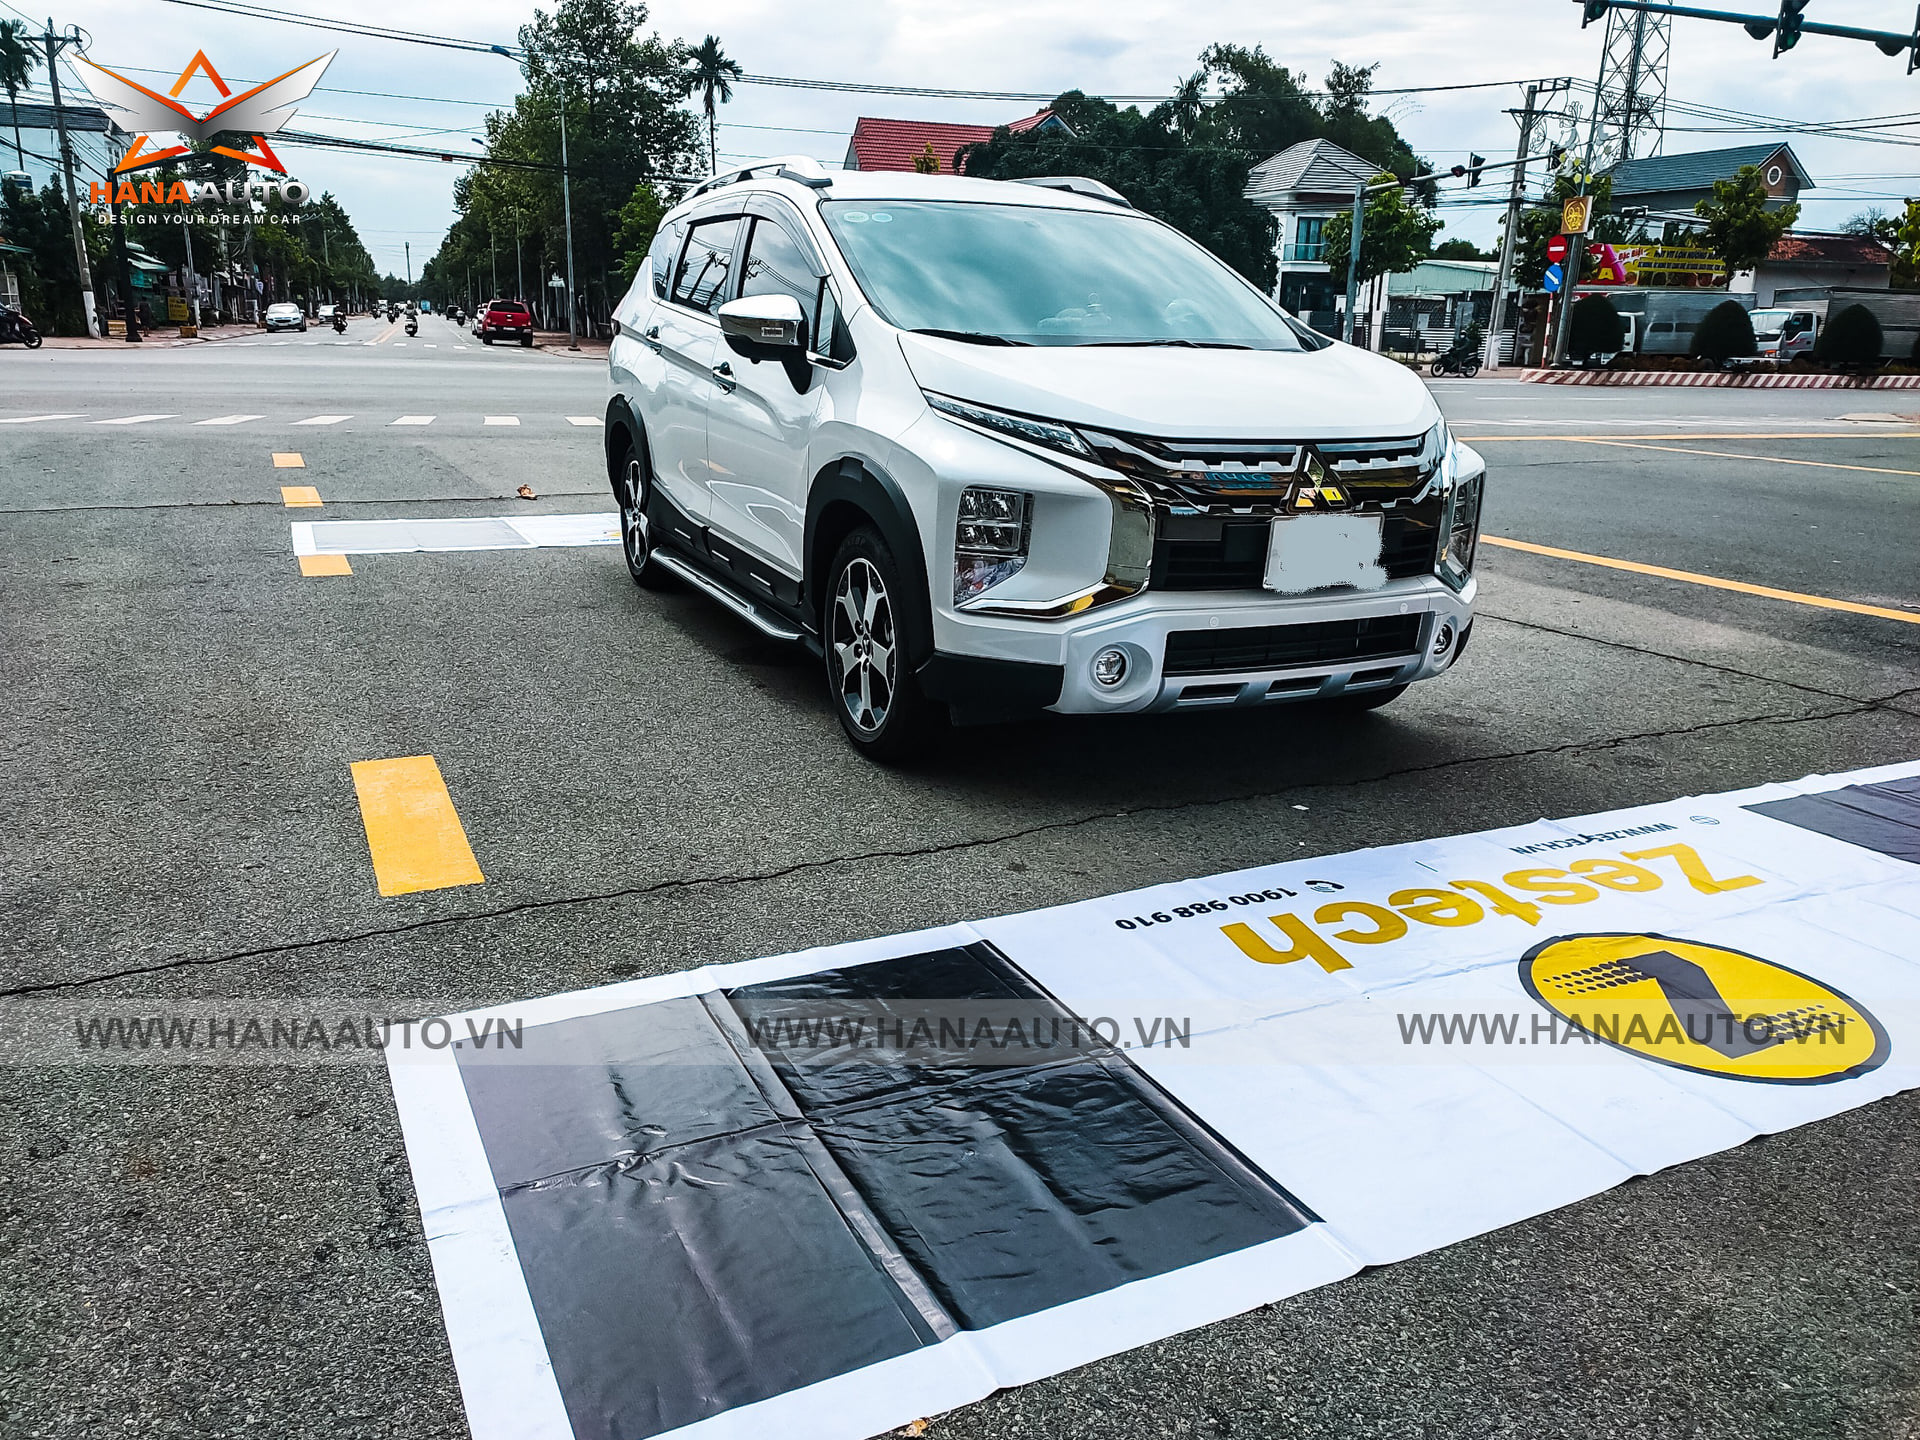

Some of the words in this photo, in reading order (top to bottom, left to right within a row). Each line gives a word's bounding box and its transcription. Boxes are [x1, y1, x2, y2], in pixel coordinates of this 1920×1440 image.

[1228, 887, 1298, 906] 1900
[1172, 900, 1229, 918] 988
[1219, 843, 1766, 974] Zestech
[1115, 911, 1173, 930] 910
